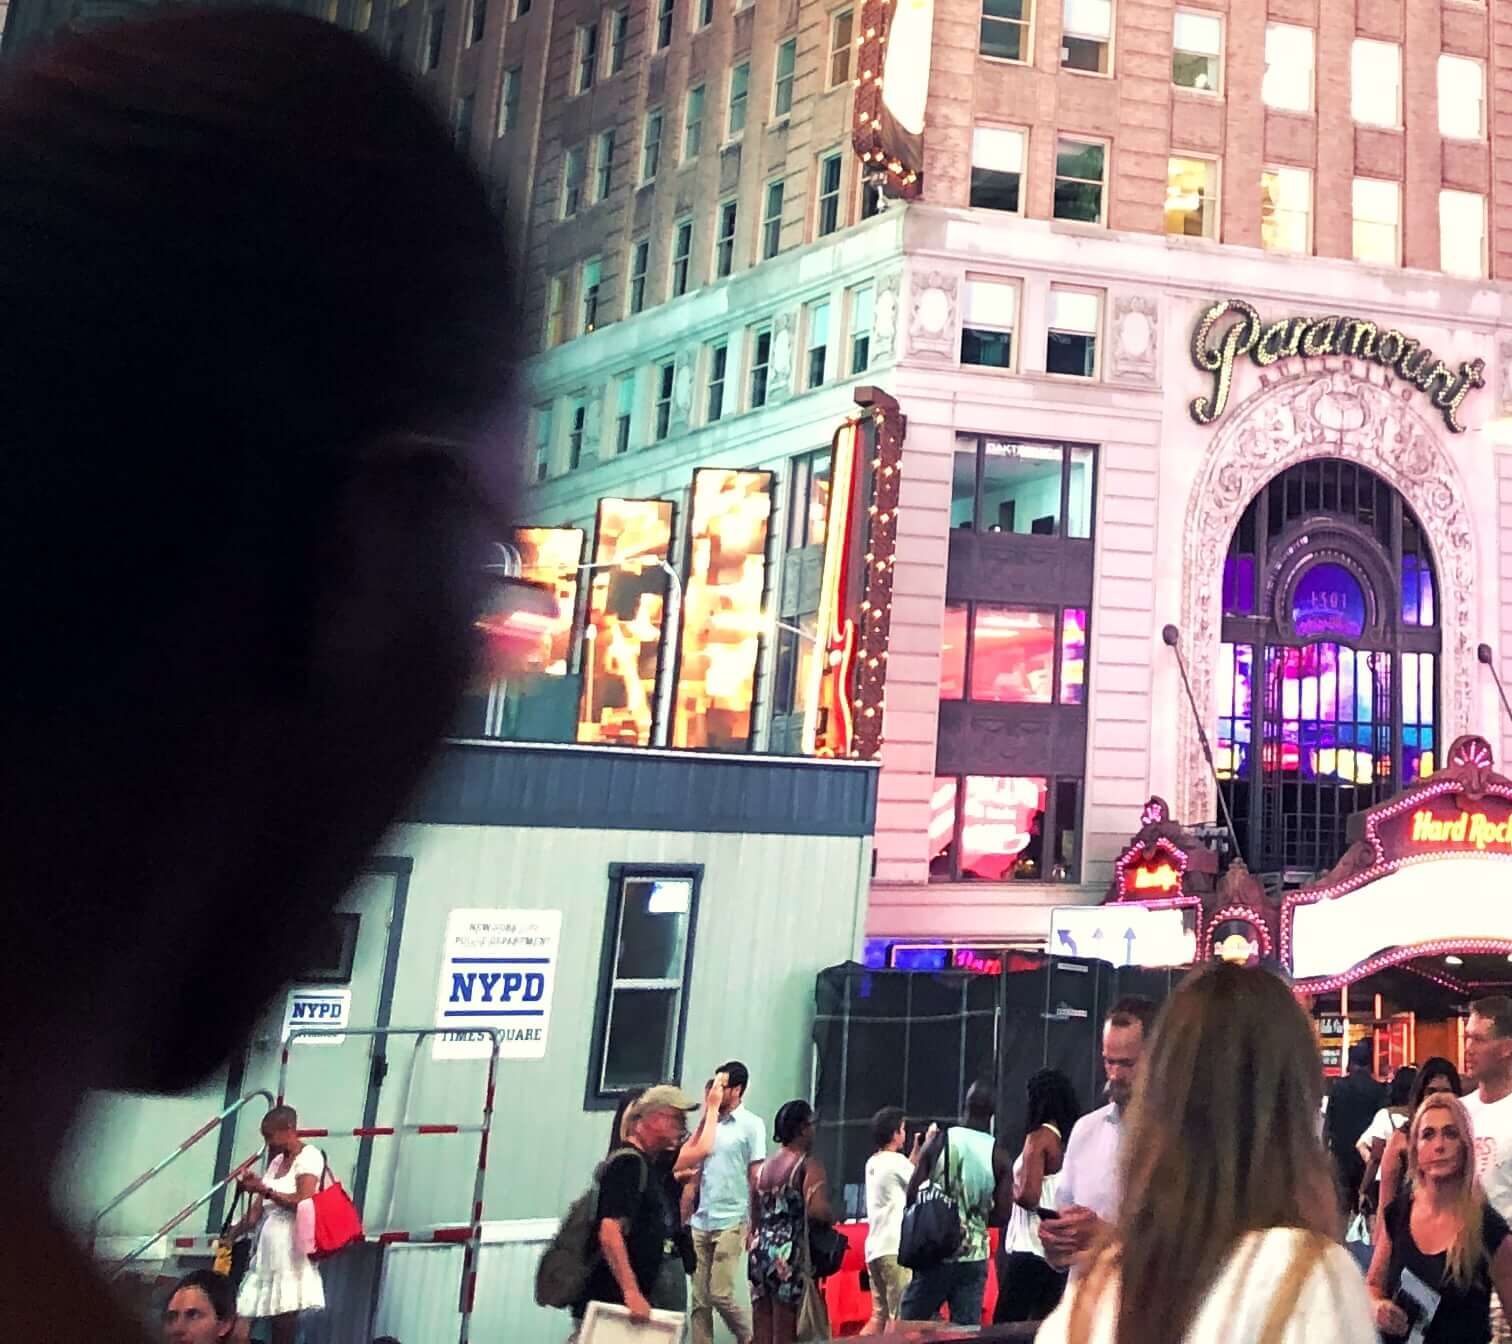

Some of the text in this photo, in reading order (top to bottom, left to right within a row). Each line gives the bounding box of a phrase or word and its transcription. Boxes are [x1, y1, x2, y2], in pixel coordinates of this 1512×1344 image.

[1190, 299, 1486, 434] Paramount
[1412, 810, 1468, 842] Hard
[449, 973, 545, 1002] NYPD
[292, 1002, 342, 1018] NYPD
